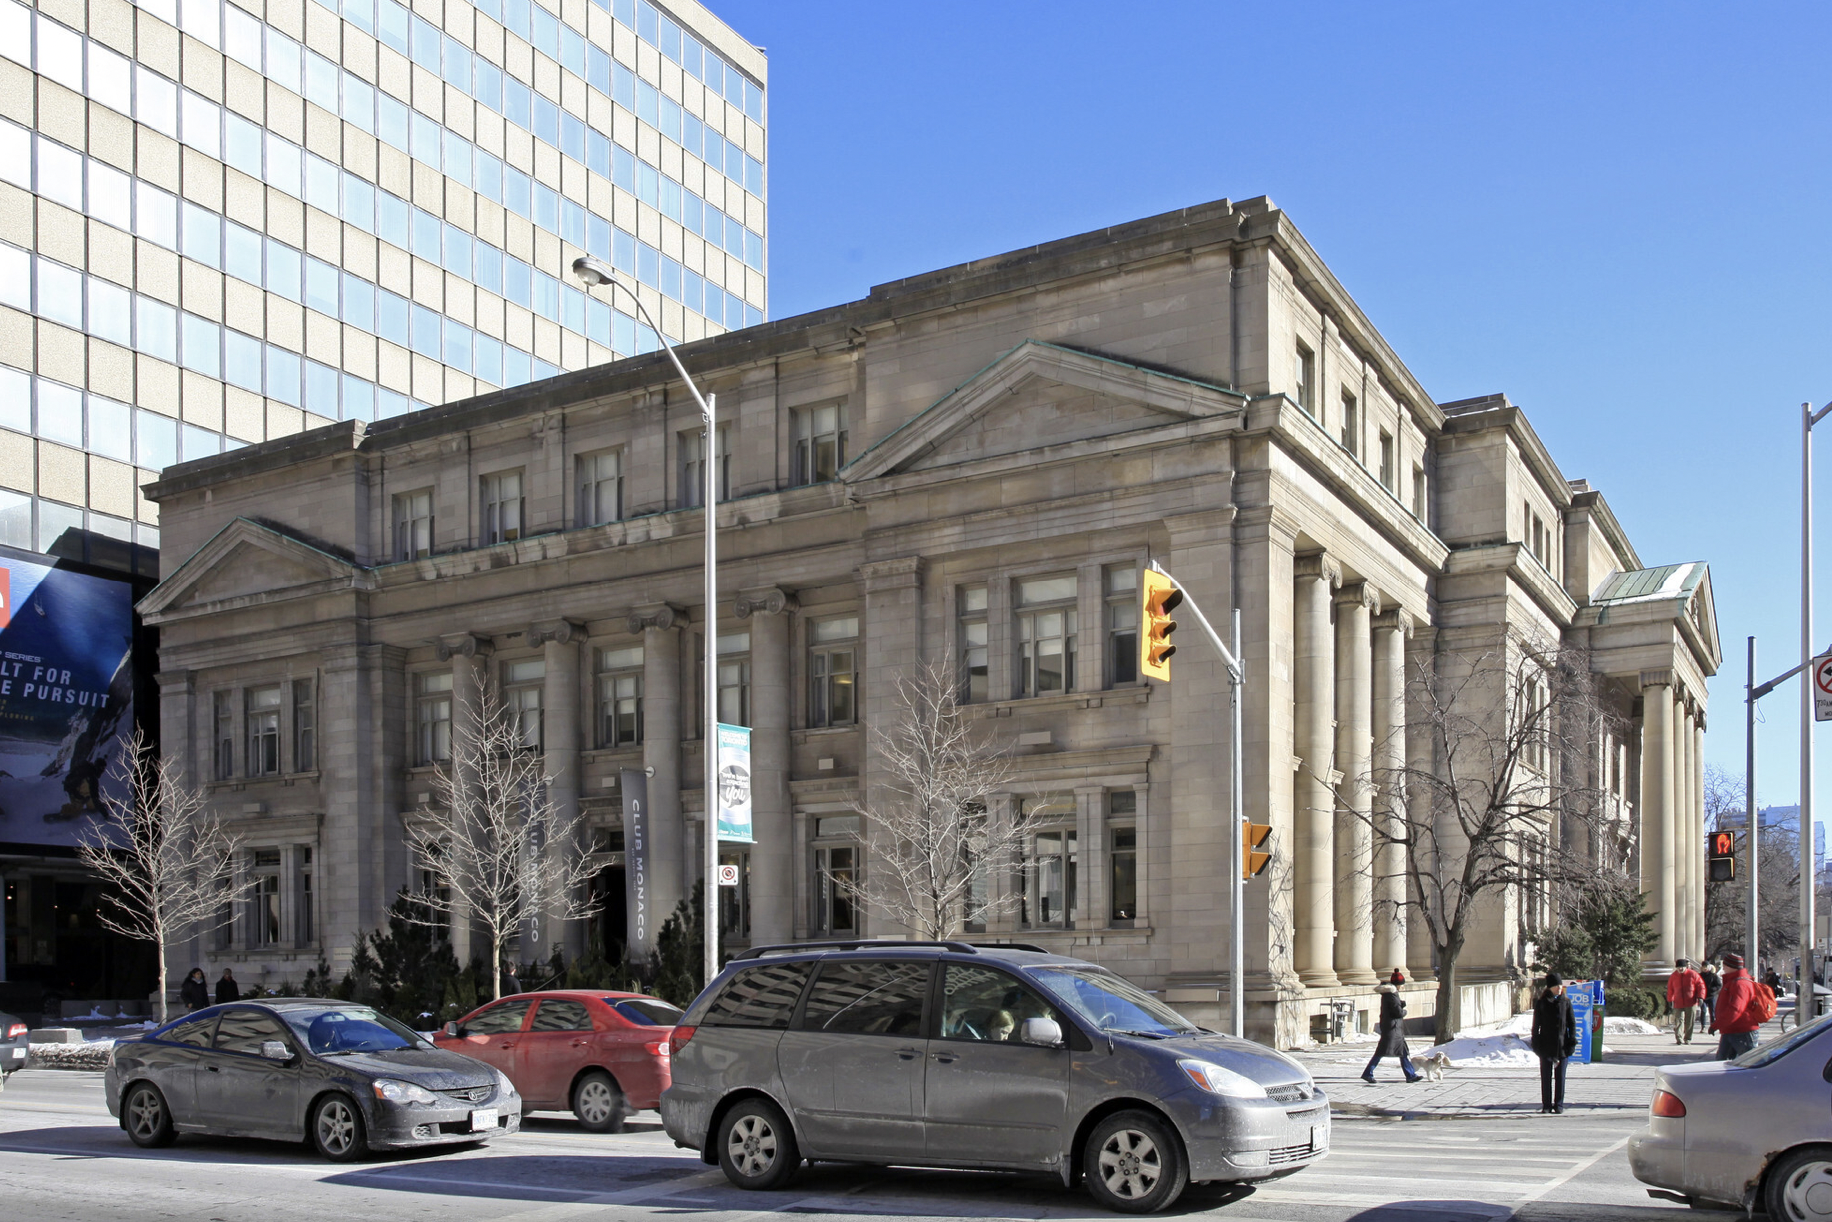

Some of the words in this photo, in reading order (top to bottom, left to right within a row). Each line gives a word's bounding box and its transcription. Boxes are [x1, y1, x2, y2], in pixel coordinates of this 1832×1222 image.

[5, 651, 42, 663] SERIES
[33, 666, 72, 685] FOR
[23, 683, 110, 708] PURSUIT
[632, 799, 643, 851] CLUB
[636, 857, 645, 940] MONACO
[1570, 993, 1590, 1003] JOB
